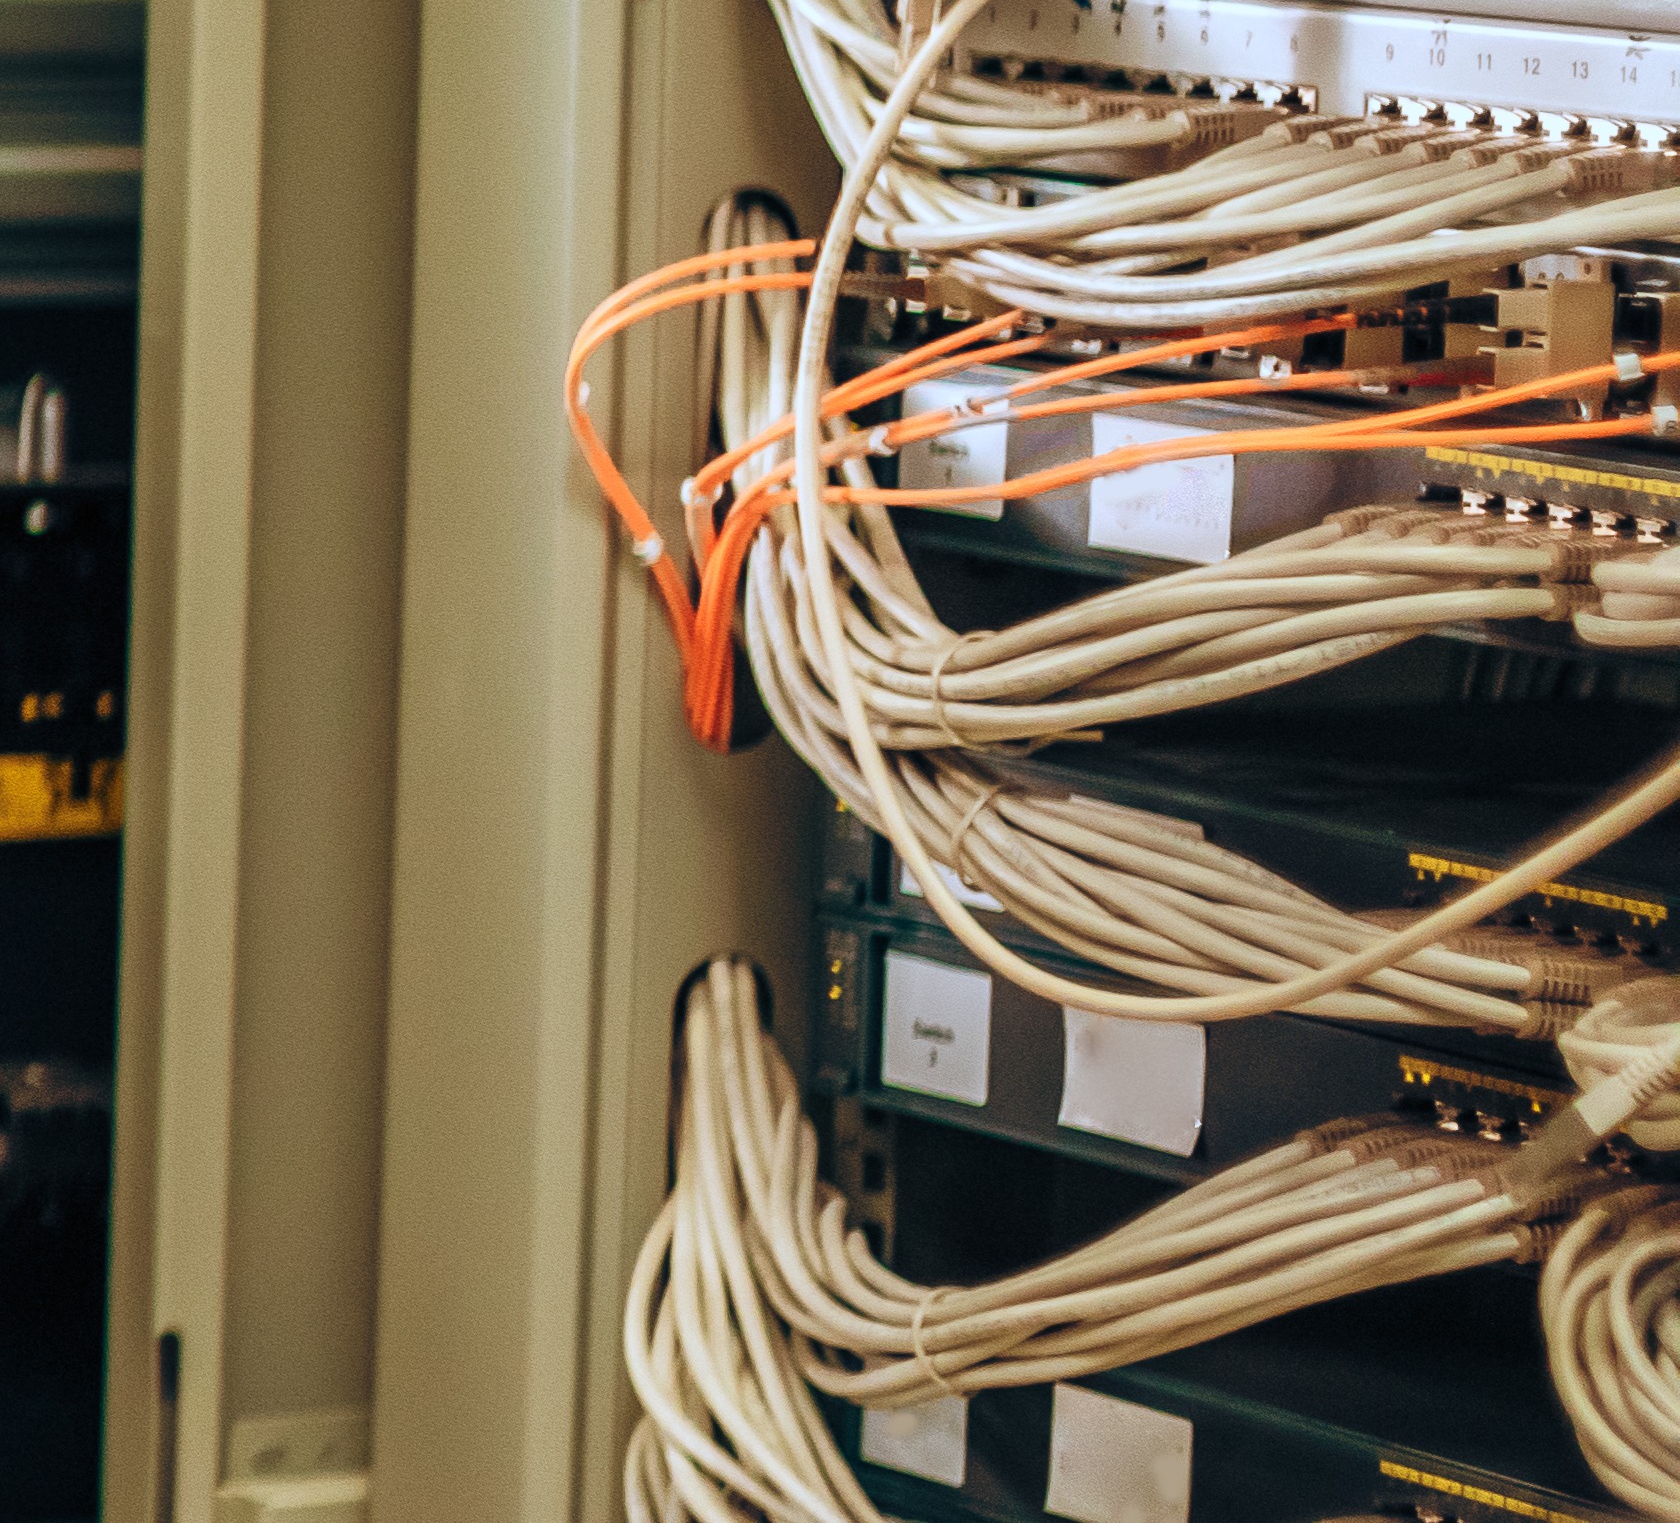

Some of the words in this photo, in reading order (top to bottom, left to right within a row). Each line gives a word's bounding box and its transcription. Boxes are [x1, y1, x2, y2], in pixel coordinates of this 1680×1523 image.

[1384, 41, 1396, 63] 9
[1427, 46, 1447, 69] 10
[1475, 51, 1494, 72] 11
[1522, 56, 1542, 77] 12
[1570, 60, 1591, 82] 13
[1619, 64, 1640, 86] 14
